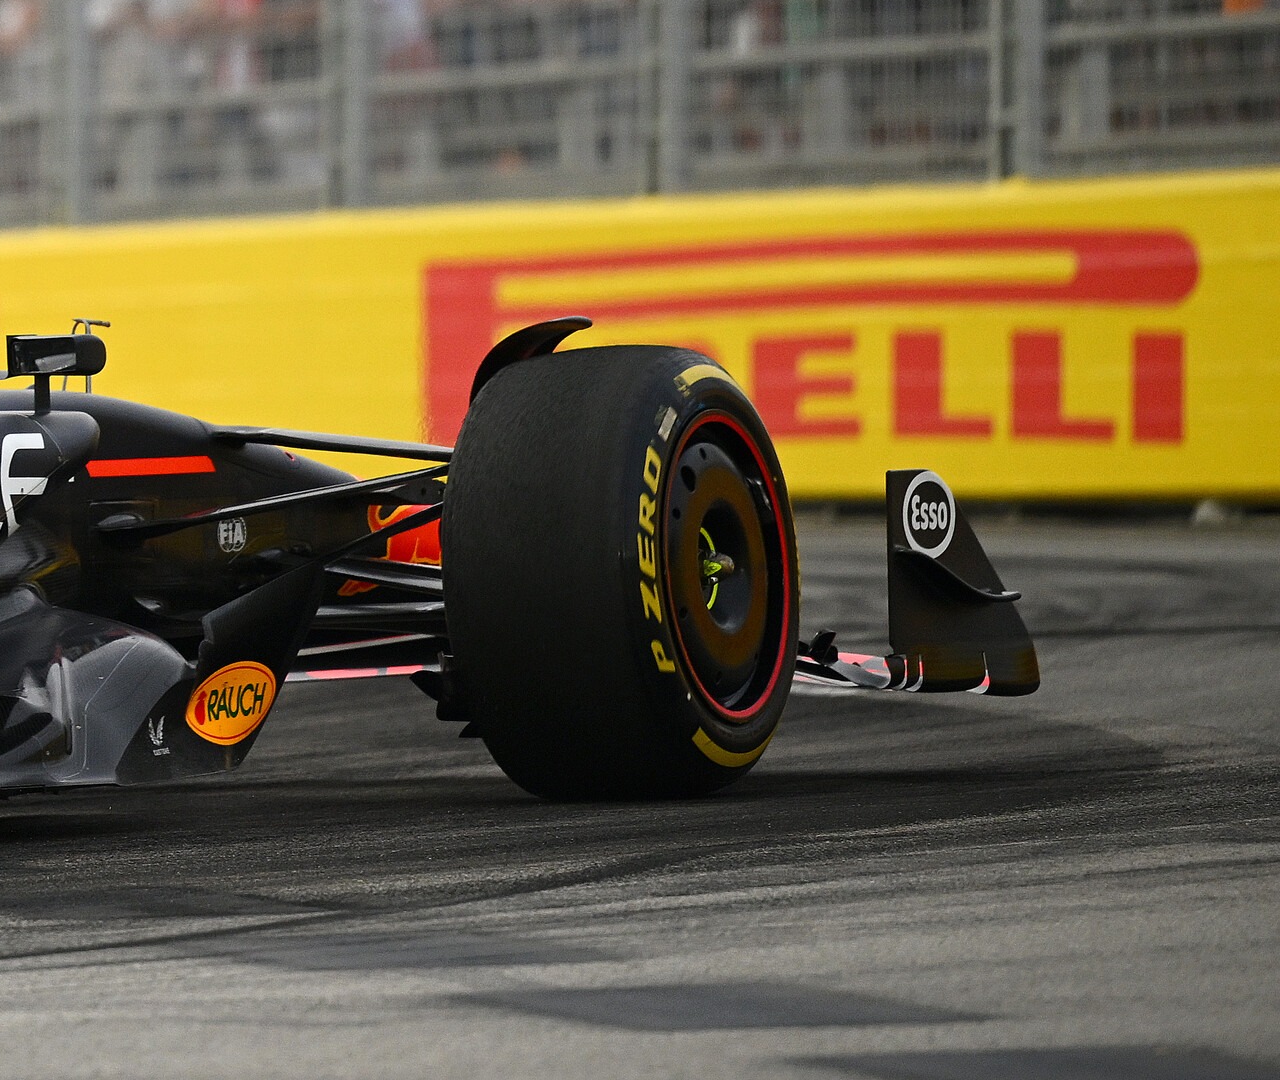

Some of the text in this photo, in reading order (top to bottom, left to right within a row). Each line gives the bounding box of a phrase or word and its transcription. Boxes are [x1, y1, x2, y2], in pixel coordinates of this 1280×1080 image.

[911, 494, 948, 531] Esso
[637, 445, 664, 624] ZERO
[207, 682, 267, 722] RAUCH
